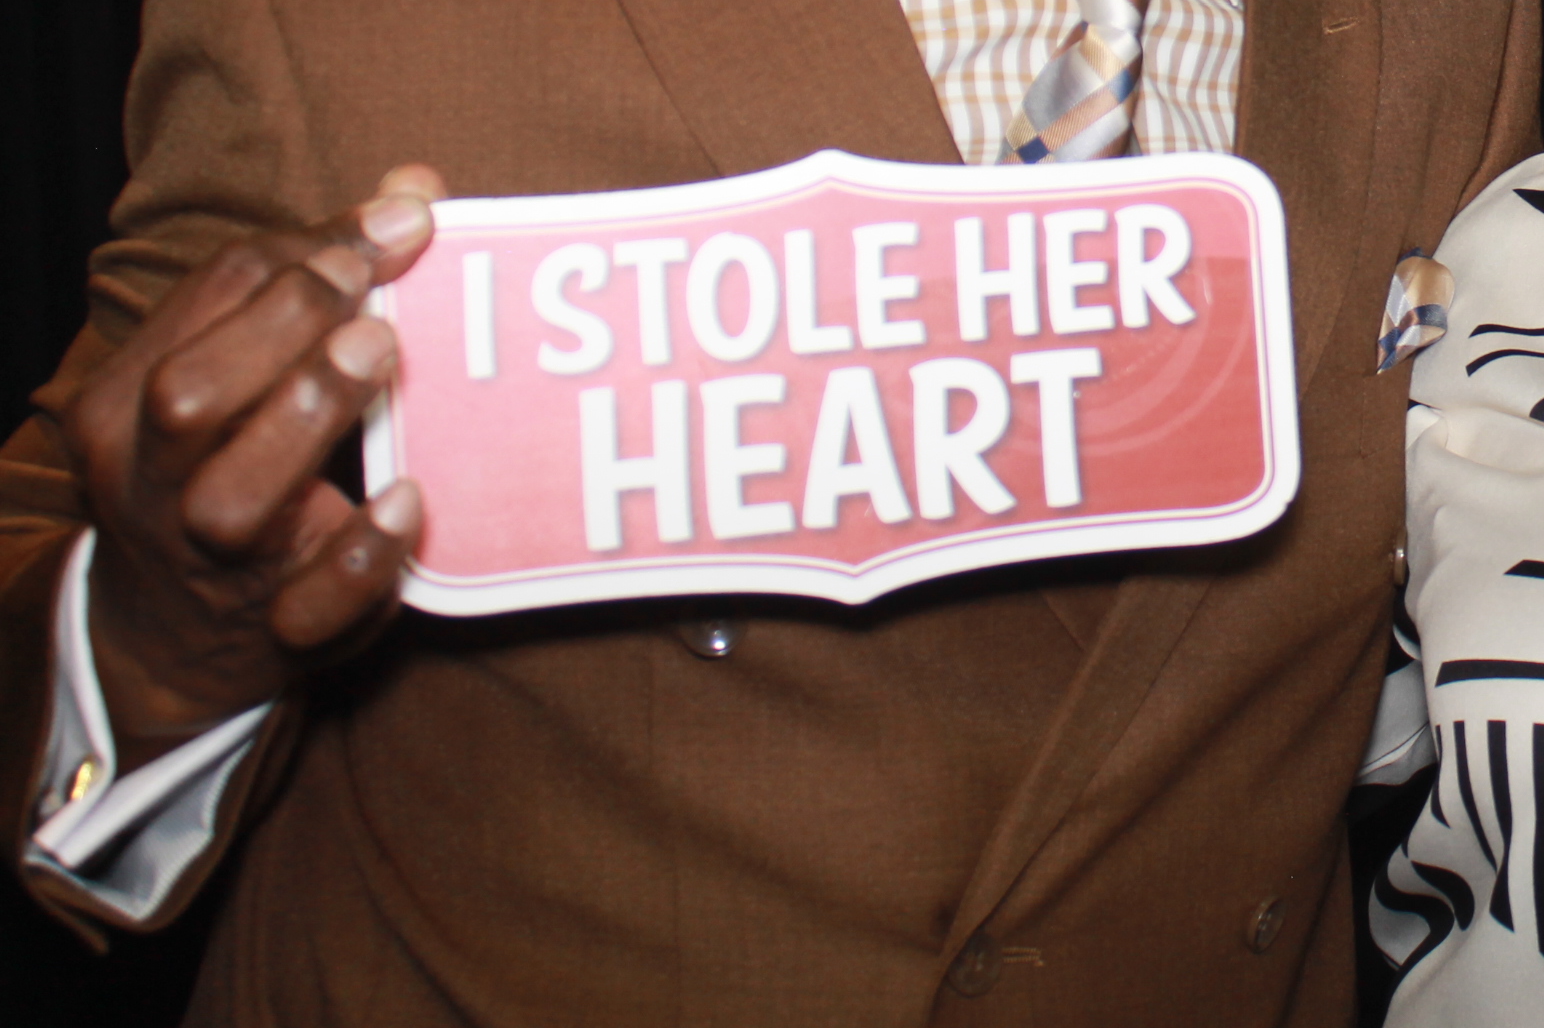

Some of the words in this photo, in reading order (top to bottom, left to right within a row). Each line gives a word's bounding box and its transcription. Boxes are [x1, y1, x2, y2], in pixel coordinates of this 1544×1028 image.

[462, 251, 497, 379] I
[530, 221, 926, 374] STOLE
[954, 204, 1197, 342] HER
[578, 347, 1103, 551] HEART
